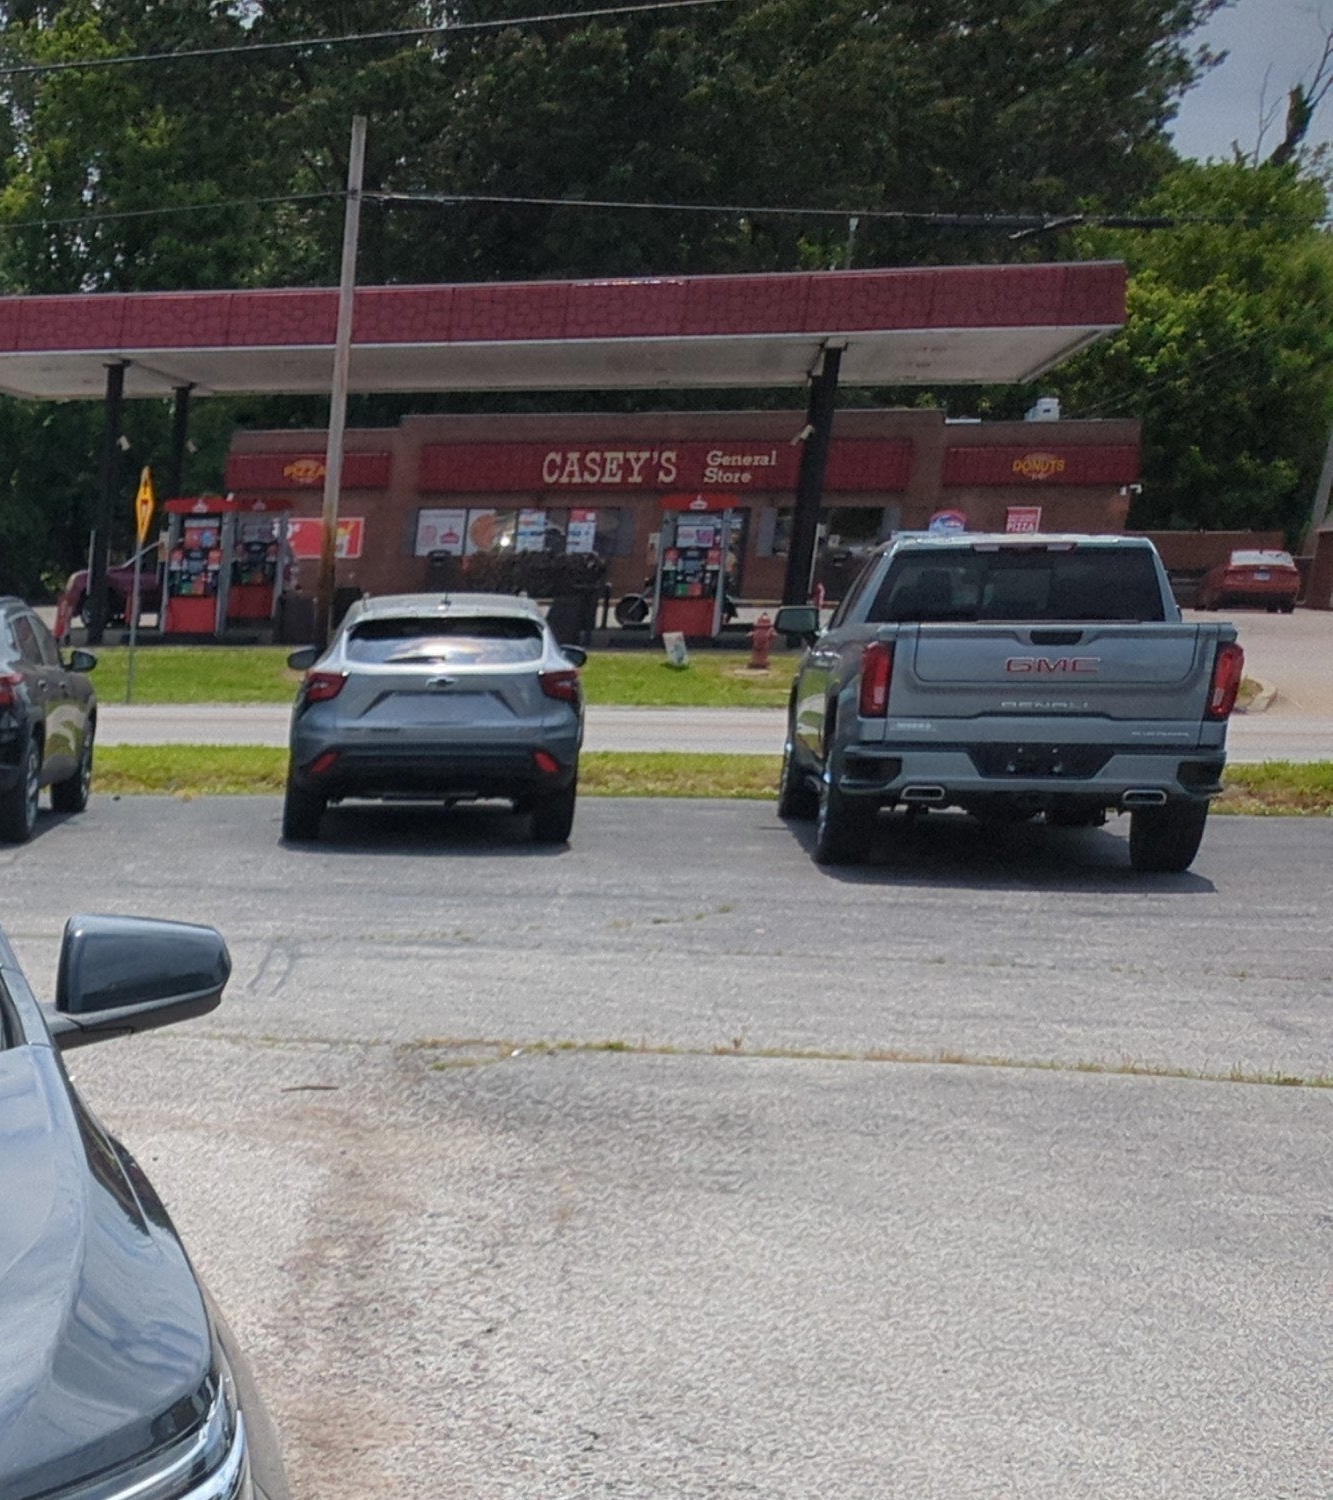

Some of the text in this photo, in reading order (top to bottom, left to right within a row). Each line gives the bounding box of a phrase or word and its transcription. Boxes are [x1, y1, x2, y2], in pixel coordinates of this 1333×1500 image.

[542, 450, 777, 484] CASEY'S General
[1012, 458, 1066, 474] DONUTS
[703, 467, 753, 484] Store
[1004, 656, 1102, 674] GMC
